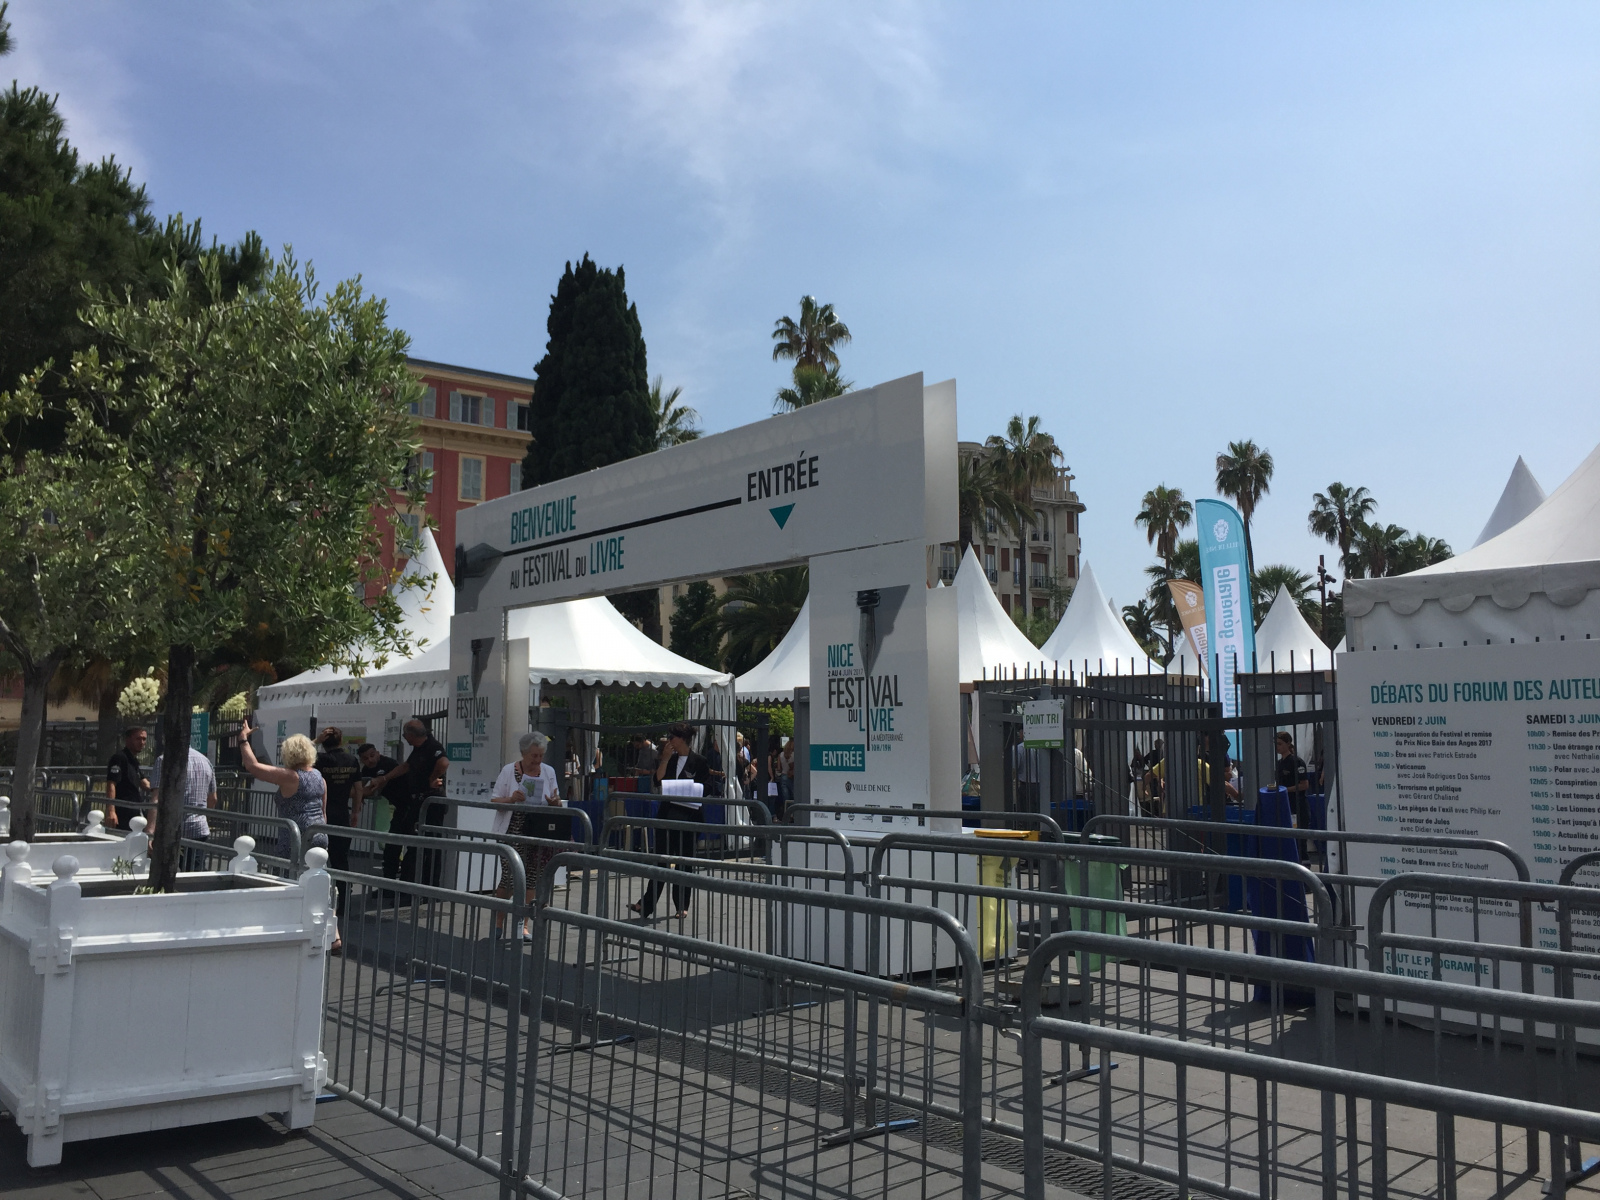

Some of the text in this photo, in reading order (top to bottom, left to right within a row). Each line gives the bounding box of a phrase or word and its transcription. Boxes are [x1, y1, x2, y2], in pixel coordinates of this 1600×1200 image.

[747, 450, 820, 502] ENTRÉE
[510, 495, 577, 545] BIENVENUE
[509, 535, 625, 590] AU FESTIVAL DU LIVRE
[828, 643, 853, 668] NICE
[457, 675, 469, 691] NICE
[828, 675, 903, 708] FESTIVAL
[1370, 681, 1424, 704] DÉBATS
[1428, 683, 1448, 703] DU
[1453, 681, 1508, 702] FORUM
[1513, 680, 1543, 701] DES
[456, 696, 490, 719] FESTIVAL
[848, 708, 894, 731] DU LIVRE
[1026, 713, 1059, 725] POINT TRI
[1372, 716, 1446, 726] VENDREDI 2 JUIN
[1526, 714, 1600, 725] SAMEDI 3 JUIN
[1568, 743, 1594, 751] étrange
[822, 747, 863, 767] ENTRÉE
[1395, 750, 1407, 758] Être
[852, 784, 891, 792] VILLE DE NICE
[1555, 778, 1597, 787] Conspiration
[1436, 785, 1462, 793] politique
[1413, 792, 1432, 800] Gérard
[1410, 805, 1428, 813] pièges
[1470, 807, 1486, 815] Philip
[1569, 805, 1595, 813] Lionnes
[1558, 831, 1588, 839] Actualité
[1534, 856, 1553, 864] 16h00
[1465, 863, 1489, 871] Neuhoff
[1403, 891, 1420, 899] Coppi
[1480, 898, 1503, 907] histoire
[1539, 941, 1558, 949] 17h50
[1385, 952, 1422, 965] TUT LE
